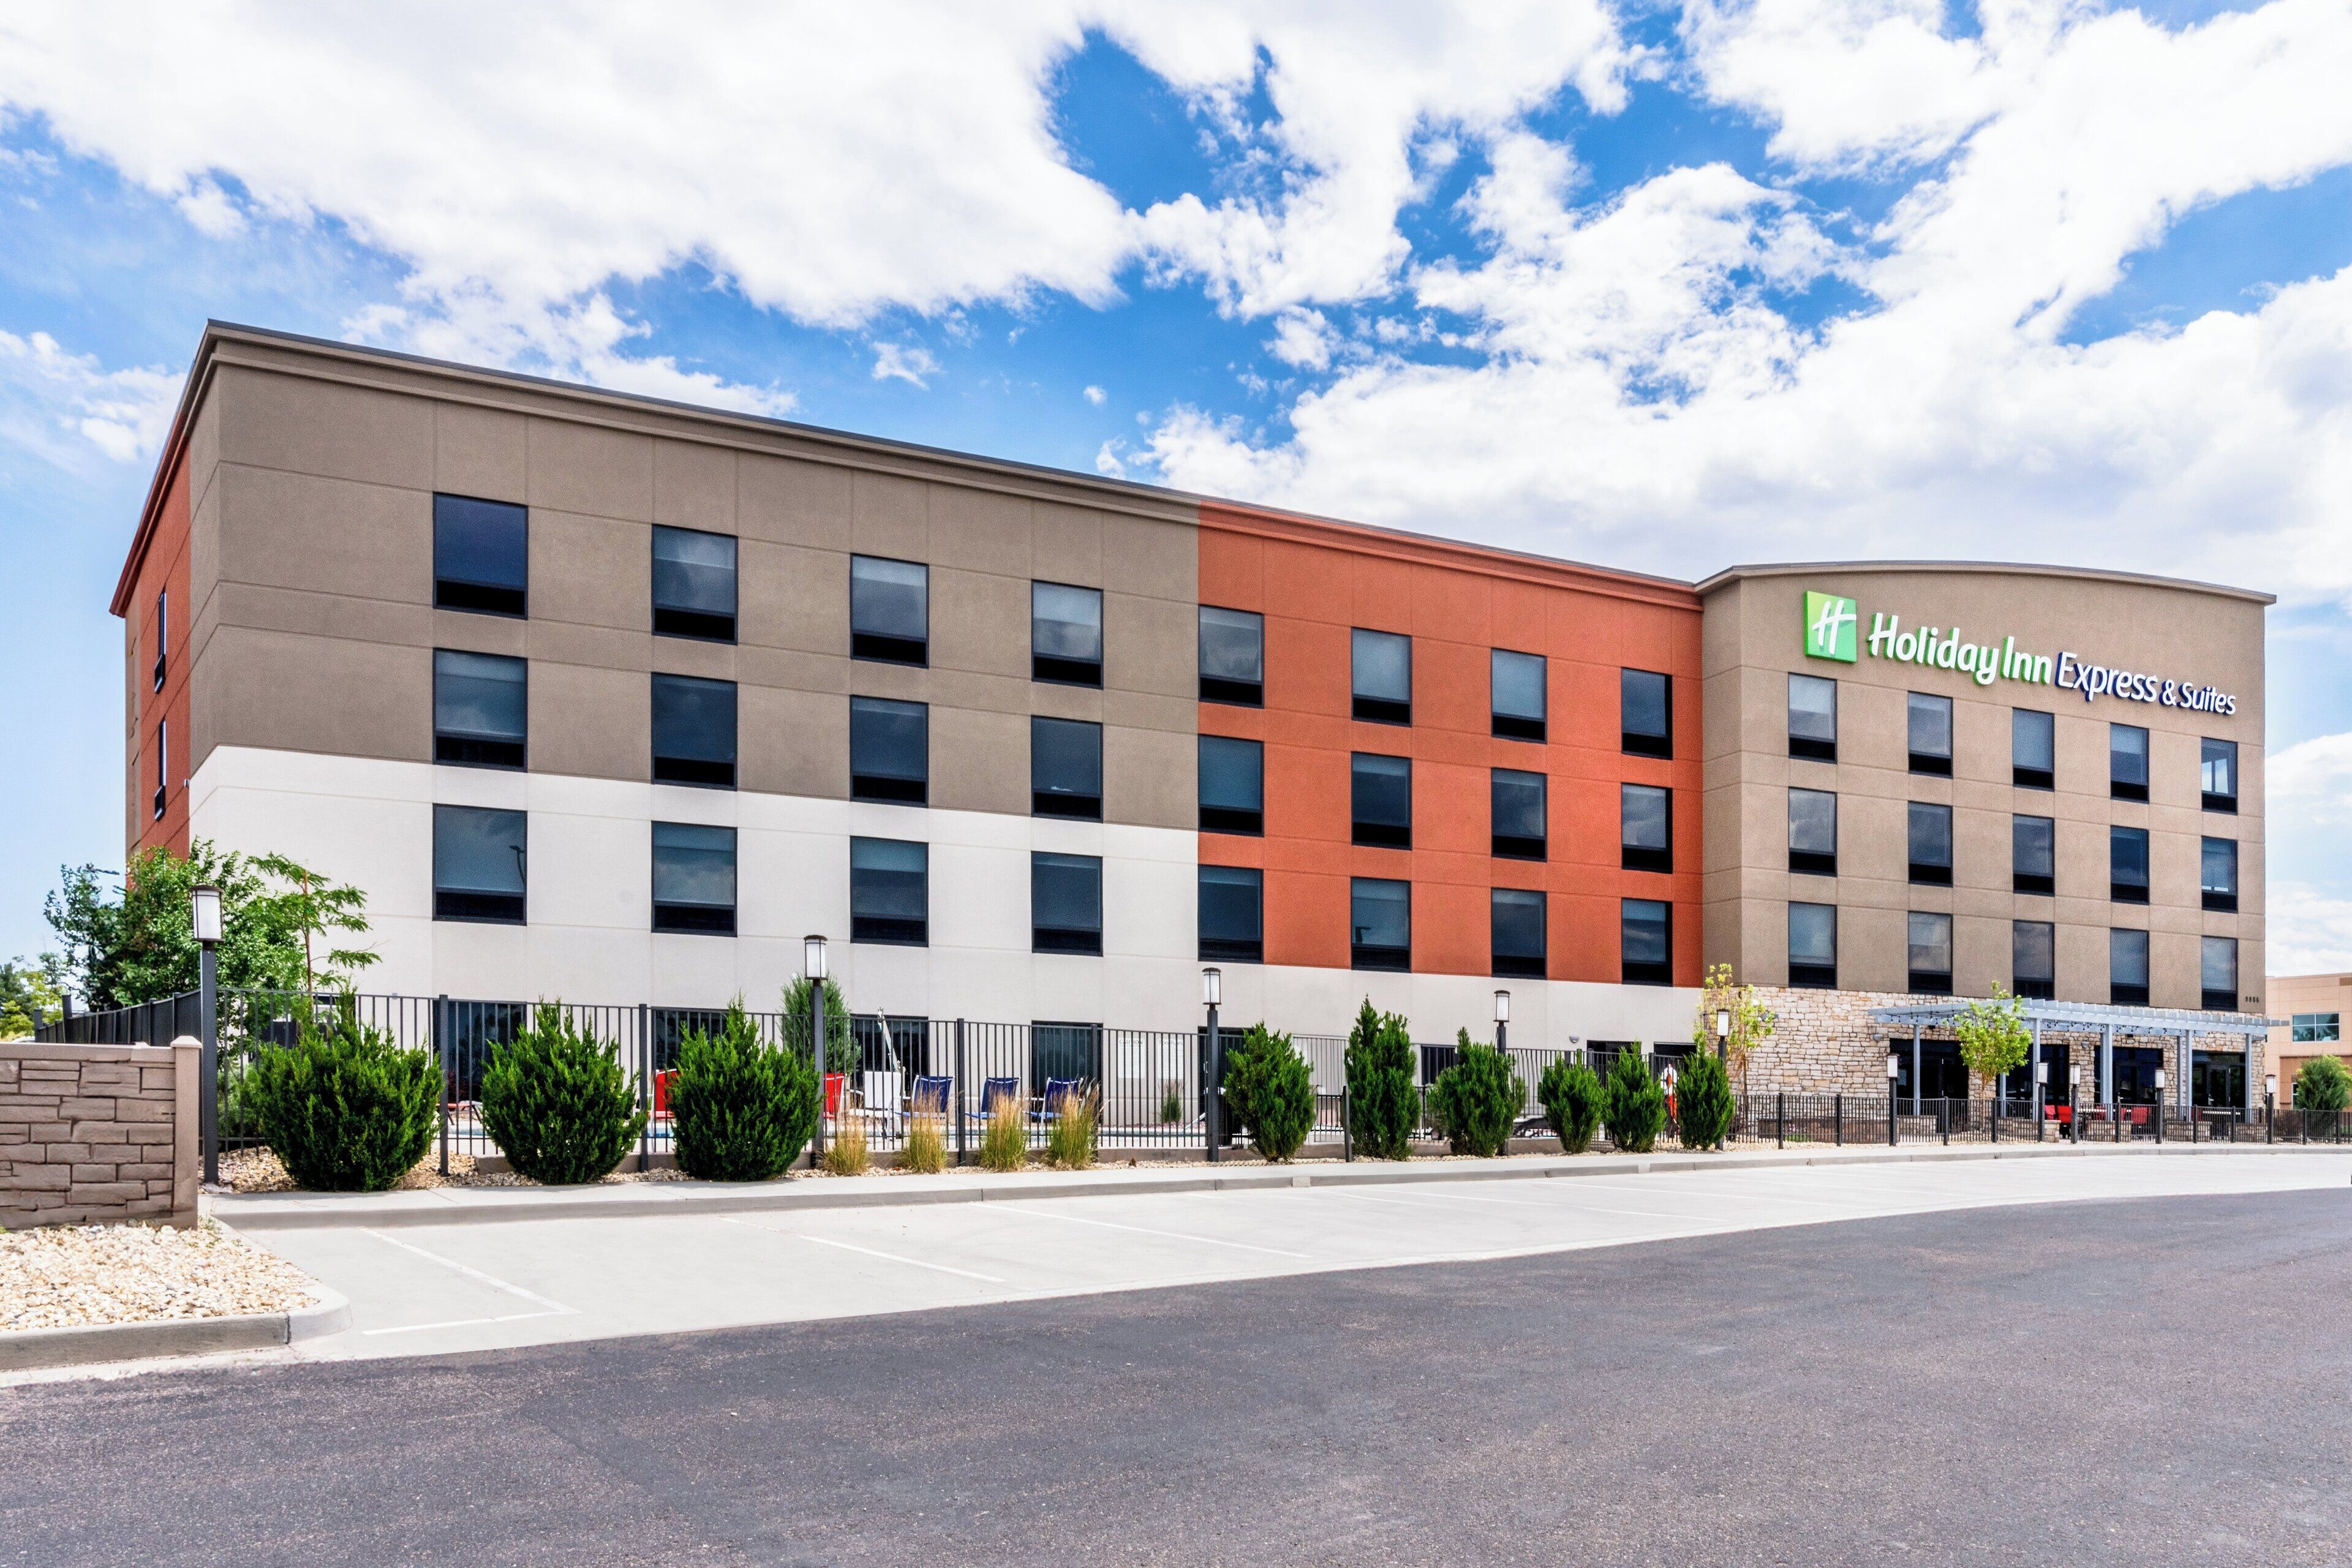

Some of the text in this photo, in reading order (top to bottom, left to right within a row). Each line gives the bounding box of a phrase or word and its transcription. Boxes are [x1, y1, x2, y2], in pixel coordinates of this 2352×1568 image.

[1867, 612, 2237, 715] Holiday Inn Express & Suites
